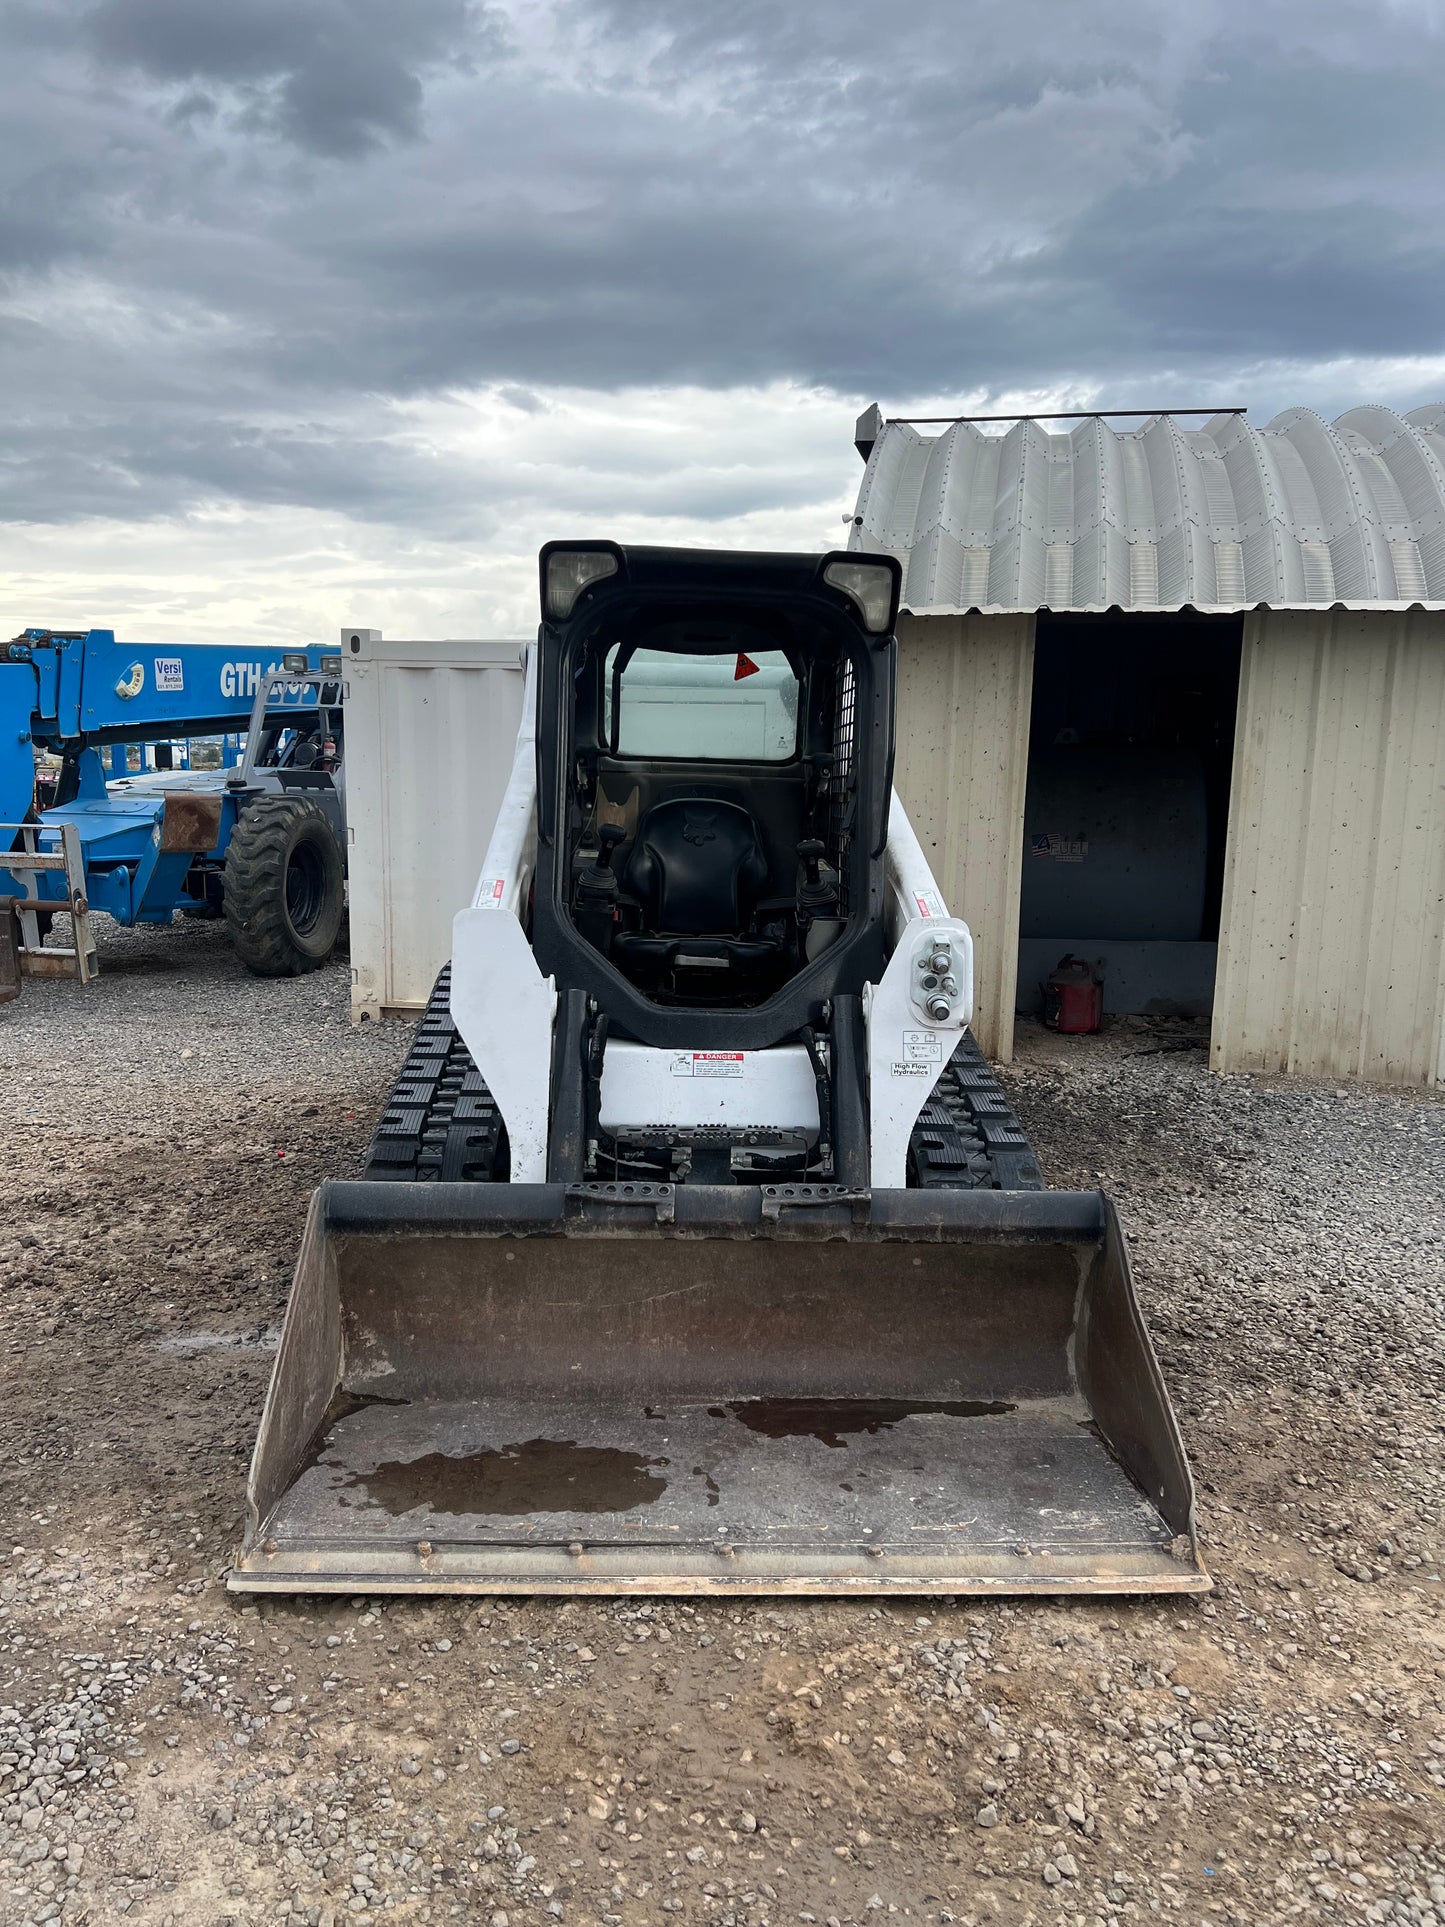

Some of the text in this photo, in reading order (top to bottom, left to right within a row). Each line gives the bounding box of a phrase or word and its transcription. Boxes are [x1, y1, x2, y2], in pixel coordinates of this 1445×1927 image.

[156, 660, 181, 674] Versi
[164, 675, 182, 683] Rentals
[1051, 842, 1087, 856] FUEL
